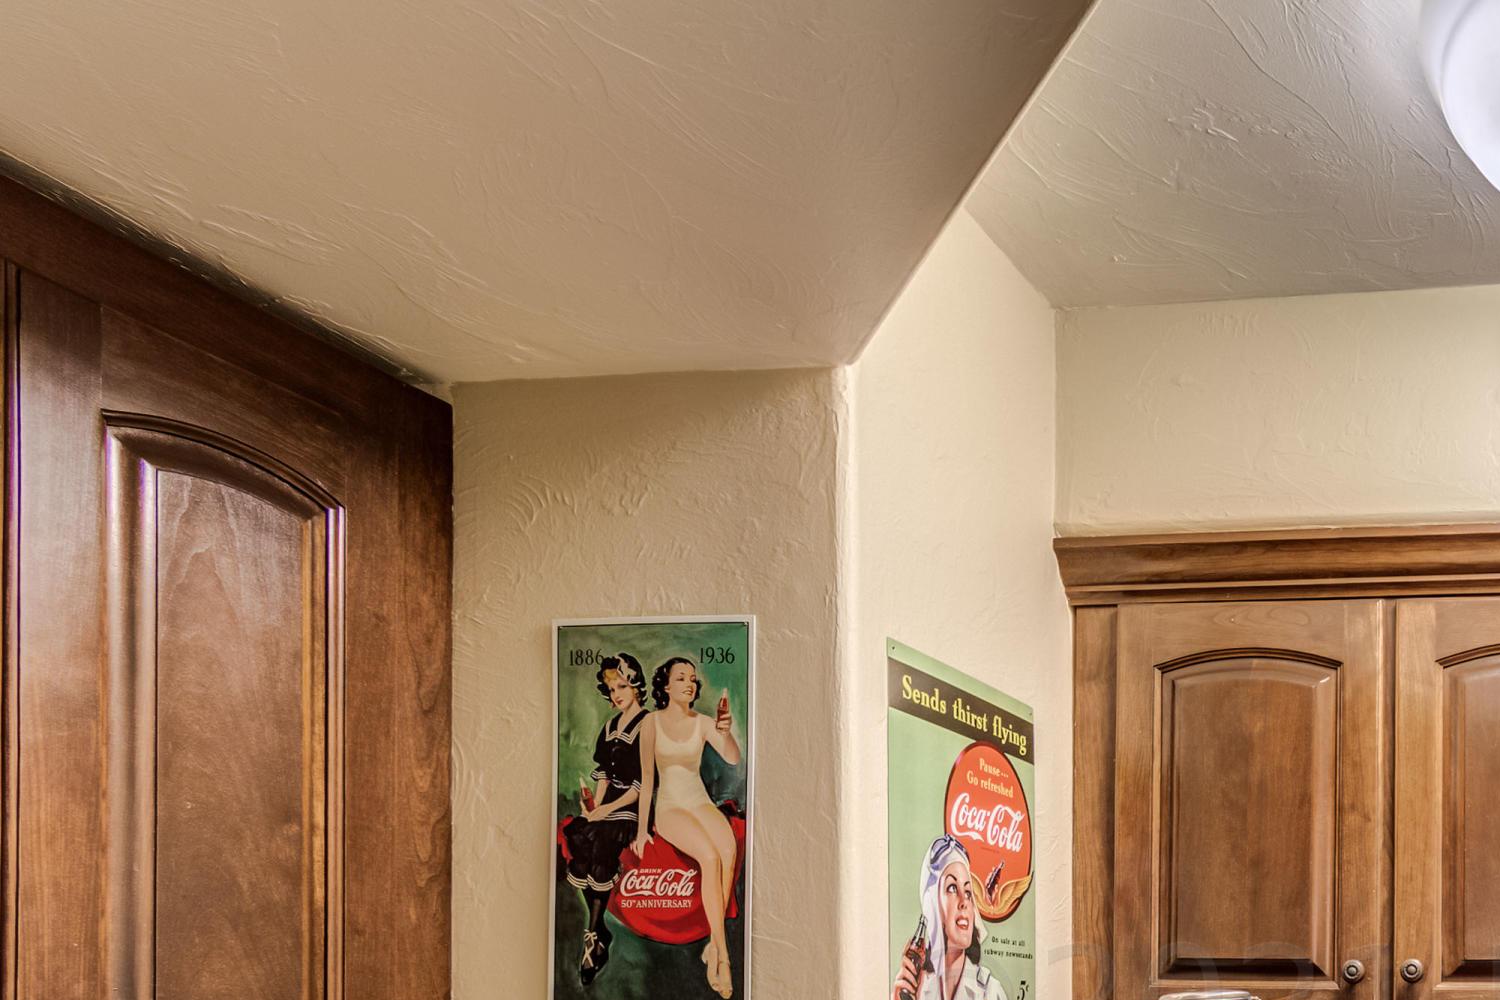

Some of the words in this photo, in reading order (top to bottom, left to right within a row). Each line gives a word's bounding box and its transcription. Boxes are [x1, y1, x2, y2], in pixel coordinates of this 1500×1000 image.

[569, 648, 605, 666] 1886
[700, 646, 735, 664] 1936
[902, 674, 947, 715] Sends
[952, 698, 988, 732] thirst
[992, 715, 1027, 756] flying
[966, 770, 978, 786] Go
[980, 778, 1013, 798] refreshed
[950, 792, 1025, 853] Coca-Cola
[620, 868, 697, 897] Coca-Cola
[636, 899, 692, 909] ANNIVERSARY
